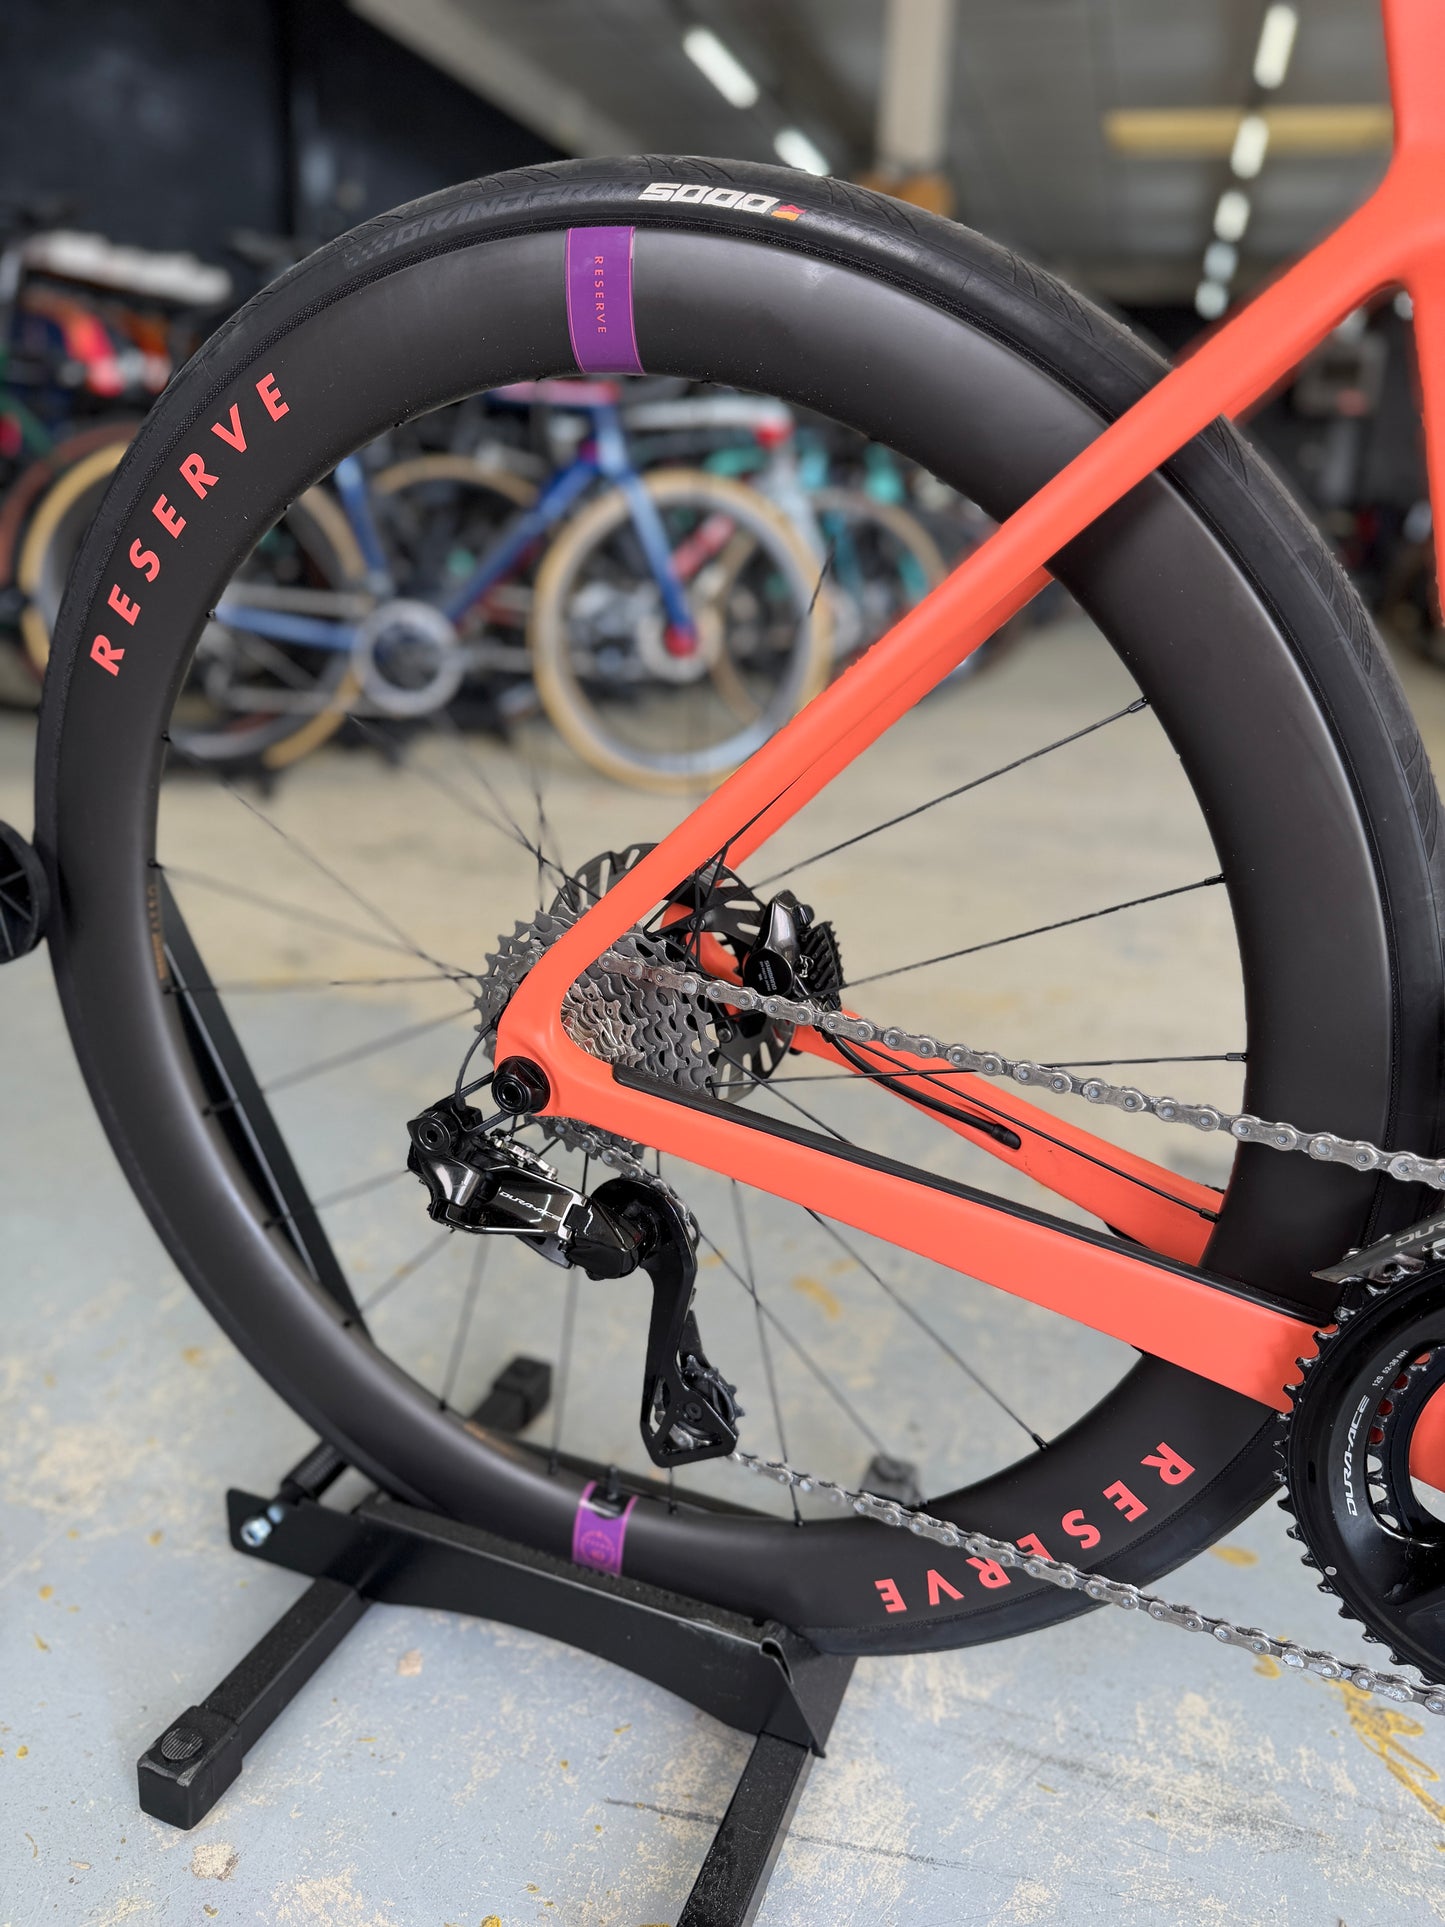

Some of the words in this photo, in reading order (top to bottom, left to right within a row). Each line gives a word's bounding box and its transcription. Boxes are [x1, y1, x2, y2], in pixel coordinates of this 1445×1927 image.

[638, 182, 782, 214] 5000
[594, 255, 607, 334] RESERVE
[90, 373, 290, 676] RESERVE
[1372, 1376, 1384, 1386] 12S
[1343, 1395, 1370, 1516] DURA-ACE
